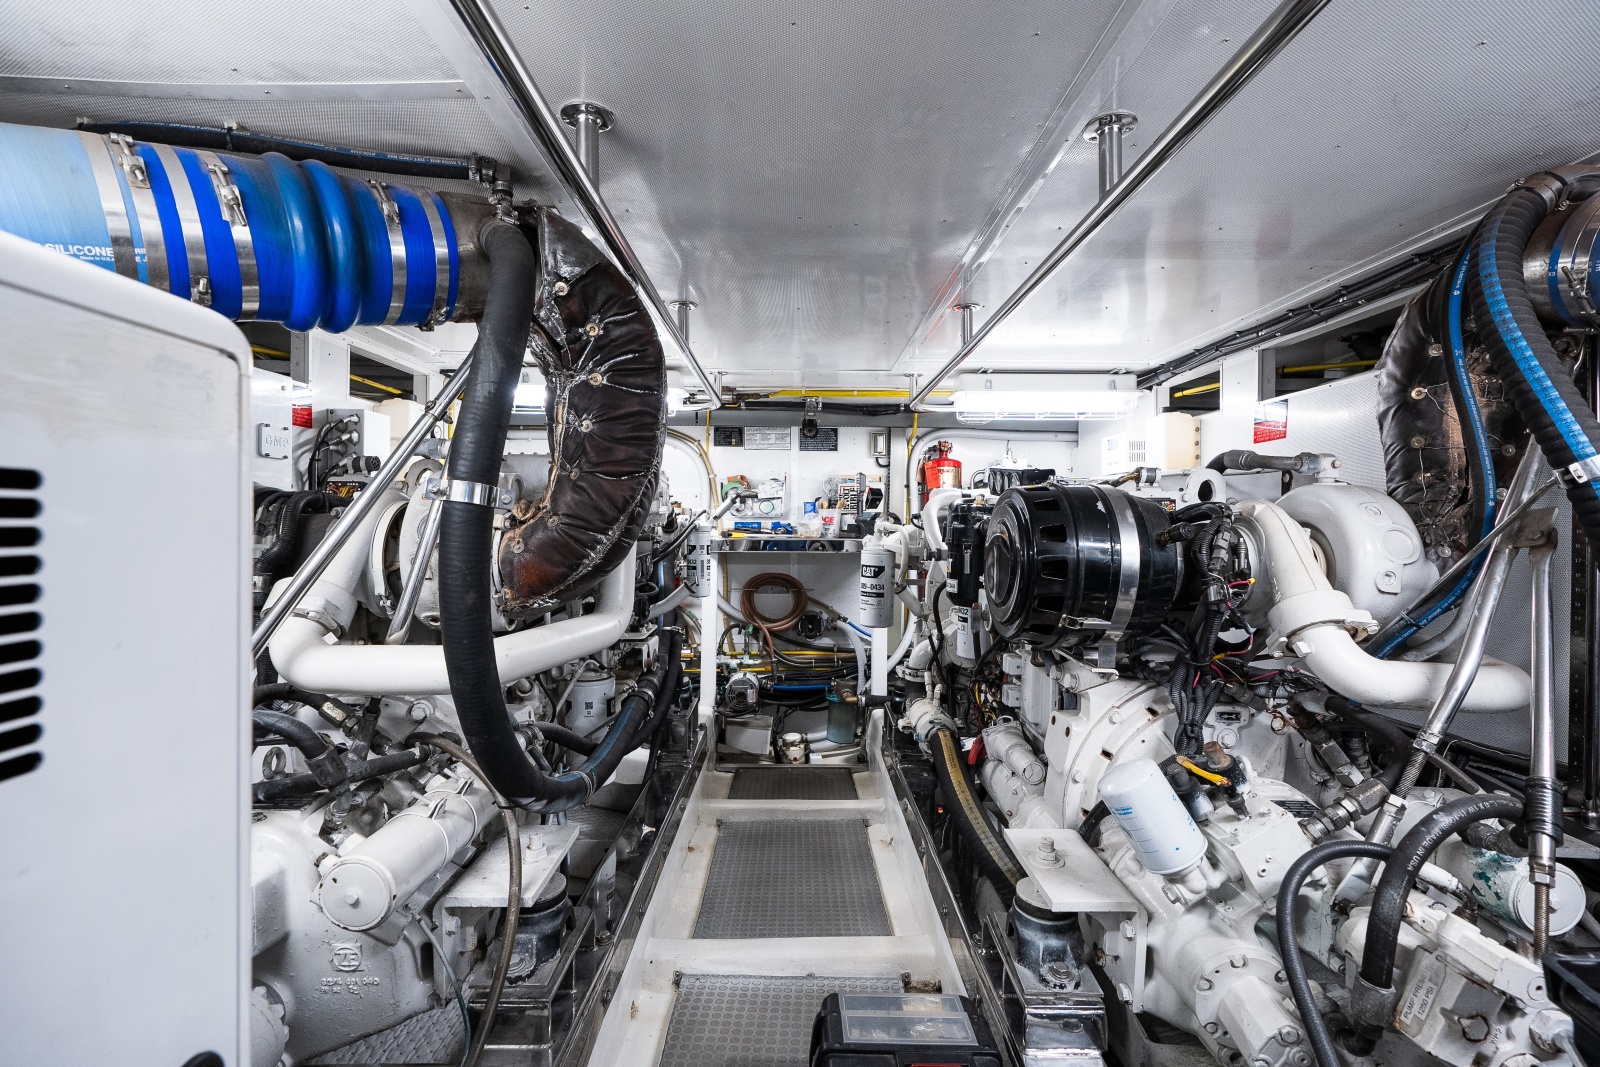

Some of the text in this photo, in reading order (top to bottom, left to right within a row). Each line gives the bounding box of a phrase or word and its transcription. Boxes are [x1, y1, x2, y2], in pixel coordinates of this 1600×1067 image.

[862, 566, 875, 577] CAT
[1422, 828, 1442, 849] MADE
[1416, 846, 1426, 857] IN
[1406, 855, 1421, 871] USA
[1402, 998, 1416, 1020] PUMP
[1417, 986, 1434, 1016] 1250 PSI
